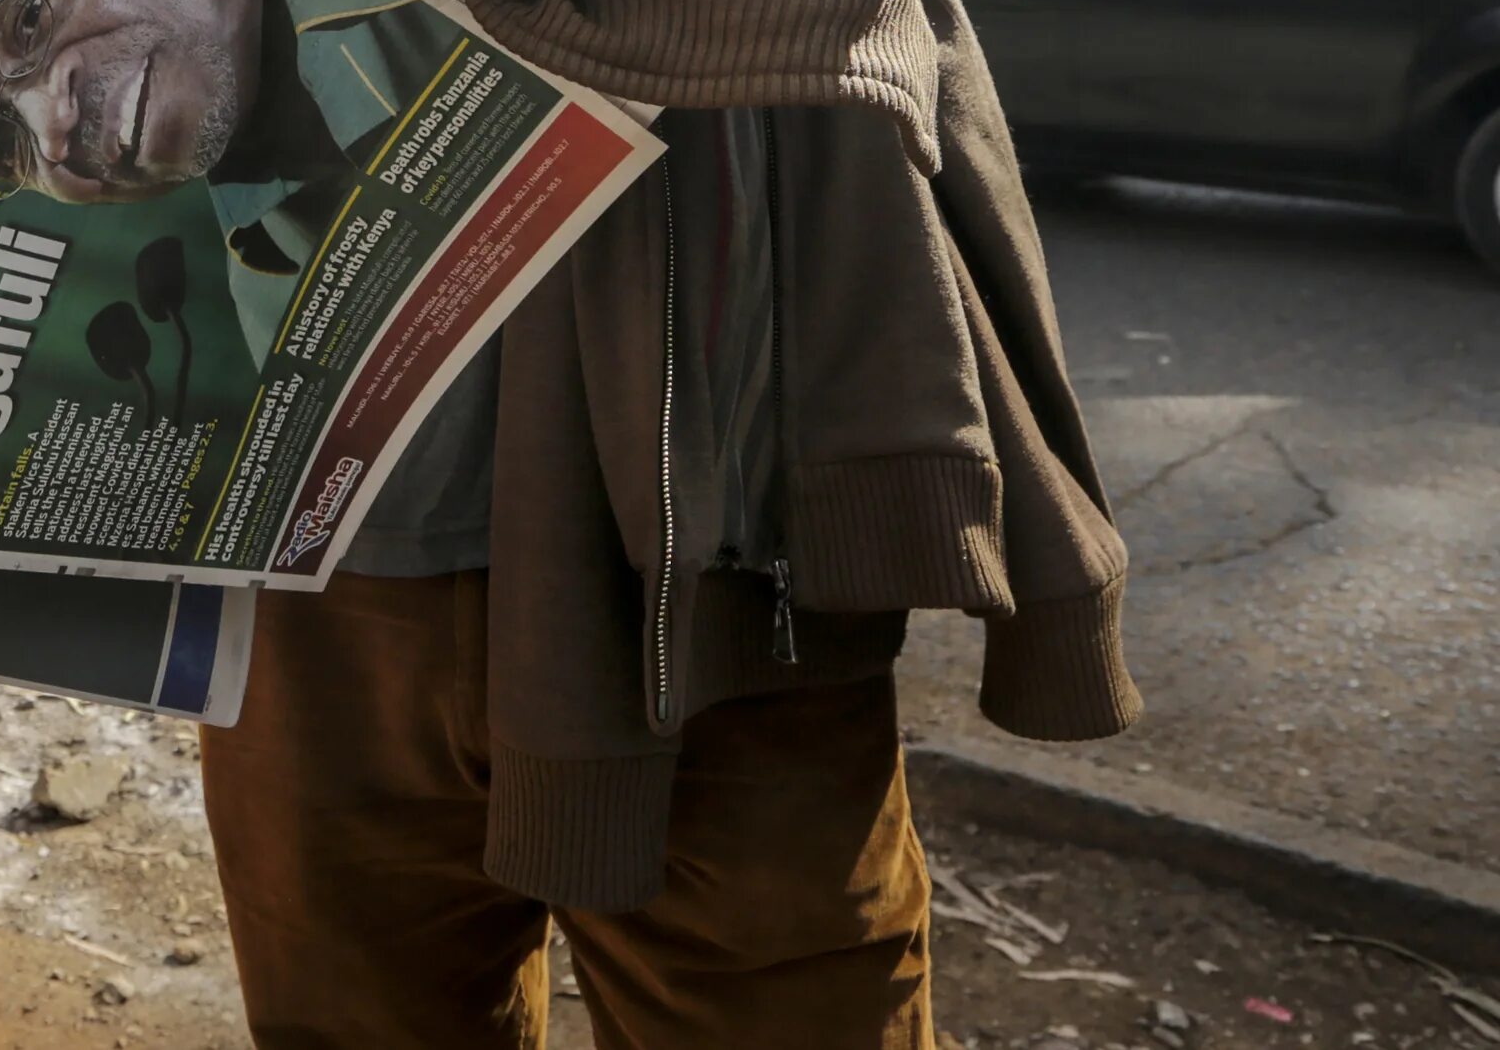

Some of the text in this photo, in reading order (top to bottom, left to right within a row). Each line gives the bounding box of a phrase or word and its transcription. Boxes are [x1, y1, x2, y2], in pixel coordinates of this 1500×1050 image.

[379, 141, 419, 184] Death
[412, 110, 442, 143] robs
[432, 51, 488, 110] Tanzania
[400, 67, 502, 193] of key personalities
[285, 216, 367, 356] A history of frosty
[294, 288, 344, 359] relations
[337, 252, 366, 286] with
[357, 208, 396, 252] Kenya
[318, 317, 348, 366] No love lost.
[3, 398, 67, 536] shaken Vice President
[10, 443, 34, 478] falls.
[27, 431, 39, 441] A
[14, 402, 79, 538] Samia Suluhu Hassan
[28, 422, 85, 539] tells the Tanzanian
[44, 416, 101, 540] nation in a televised
[57, 402, 122, 542] address last night that
[68, 406, 134, 542] President Magufuli, an
[83, 442, 131, 544] avowed Covid-19
[95, 429, 150, 545] sceptic, had died in
[106, 416, 168, 546] Mzena Hospital in Dar
[121, 426, 177, 547] es Salaam, where he
[130, 437, 187, 548] had been receiving
[143, 422, 203, 549] treatment for a heart
[181, 449, 205, 489] Pages
[183, 501, 194, 510] 7
[204, 380, 284, 560] His health shrouded in
[221, 464, 265, 561] controversy
[257, 439, 275, 462] till
[266, 405, 289, 437] last
[282, 373, 303, 403] day
[256, 496, 266, 511] the
[304, 457, 356, 538] Maisha
[174, 526, 184, 535] 6
[179, 513, 190, 524] &
